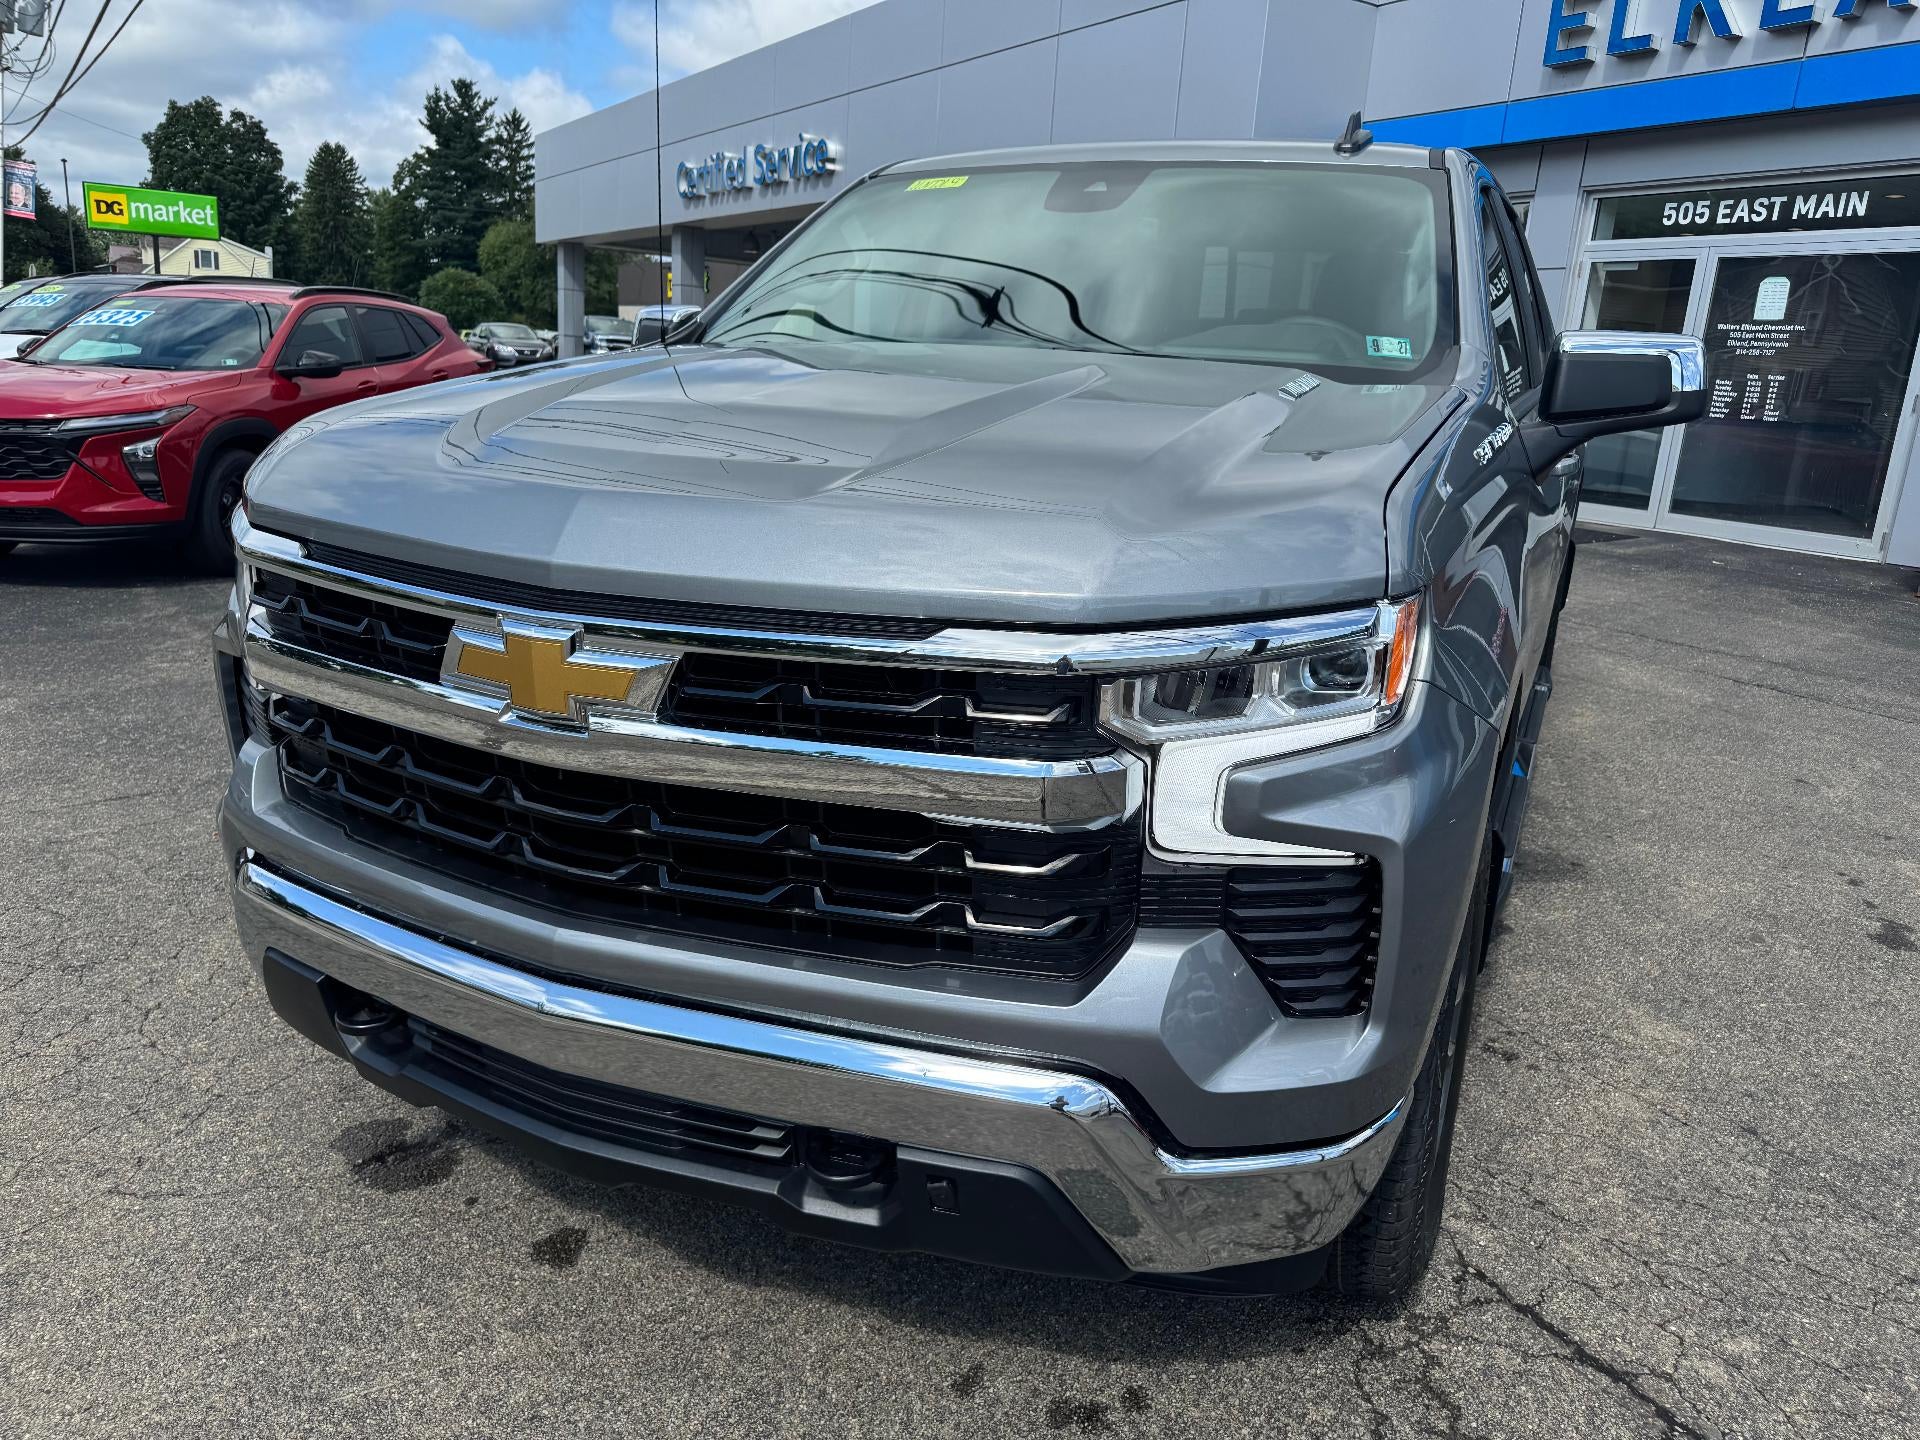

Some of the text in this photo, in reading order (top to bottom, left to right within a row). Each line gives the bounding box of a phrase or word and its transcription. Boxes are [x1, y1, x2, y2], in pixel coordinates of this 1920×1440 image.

[677, 132, 832, 199] Certified Service
[94, 198, 216, 227] DG market
[1662, 190, 1870, 226] 505 EAST MAIN
[1729, 331, 1742, 339] 505
[1742, 331, 1755, 339] East
[1741, 323, 1764, 331] Elkland
[1372, 338, 1408, 356] 9 27
[1749, 340, 1789, 349] Pennsylvania
